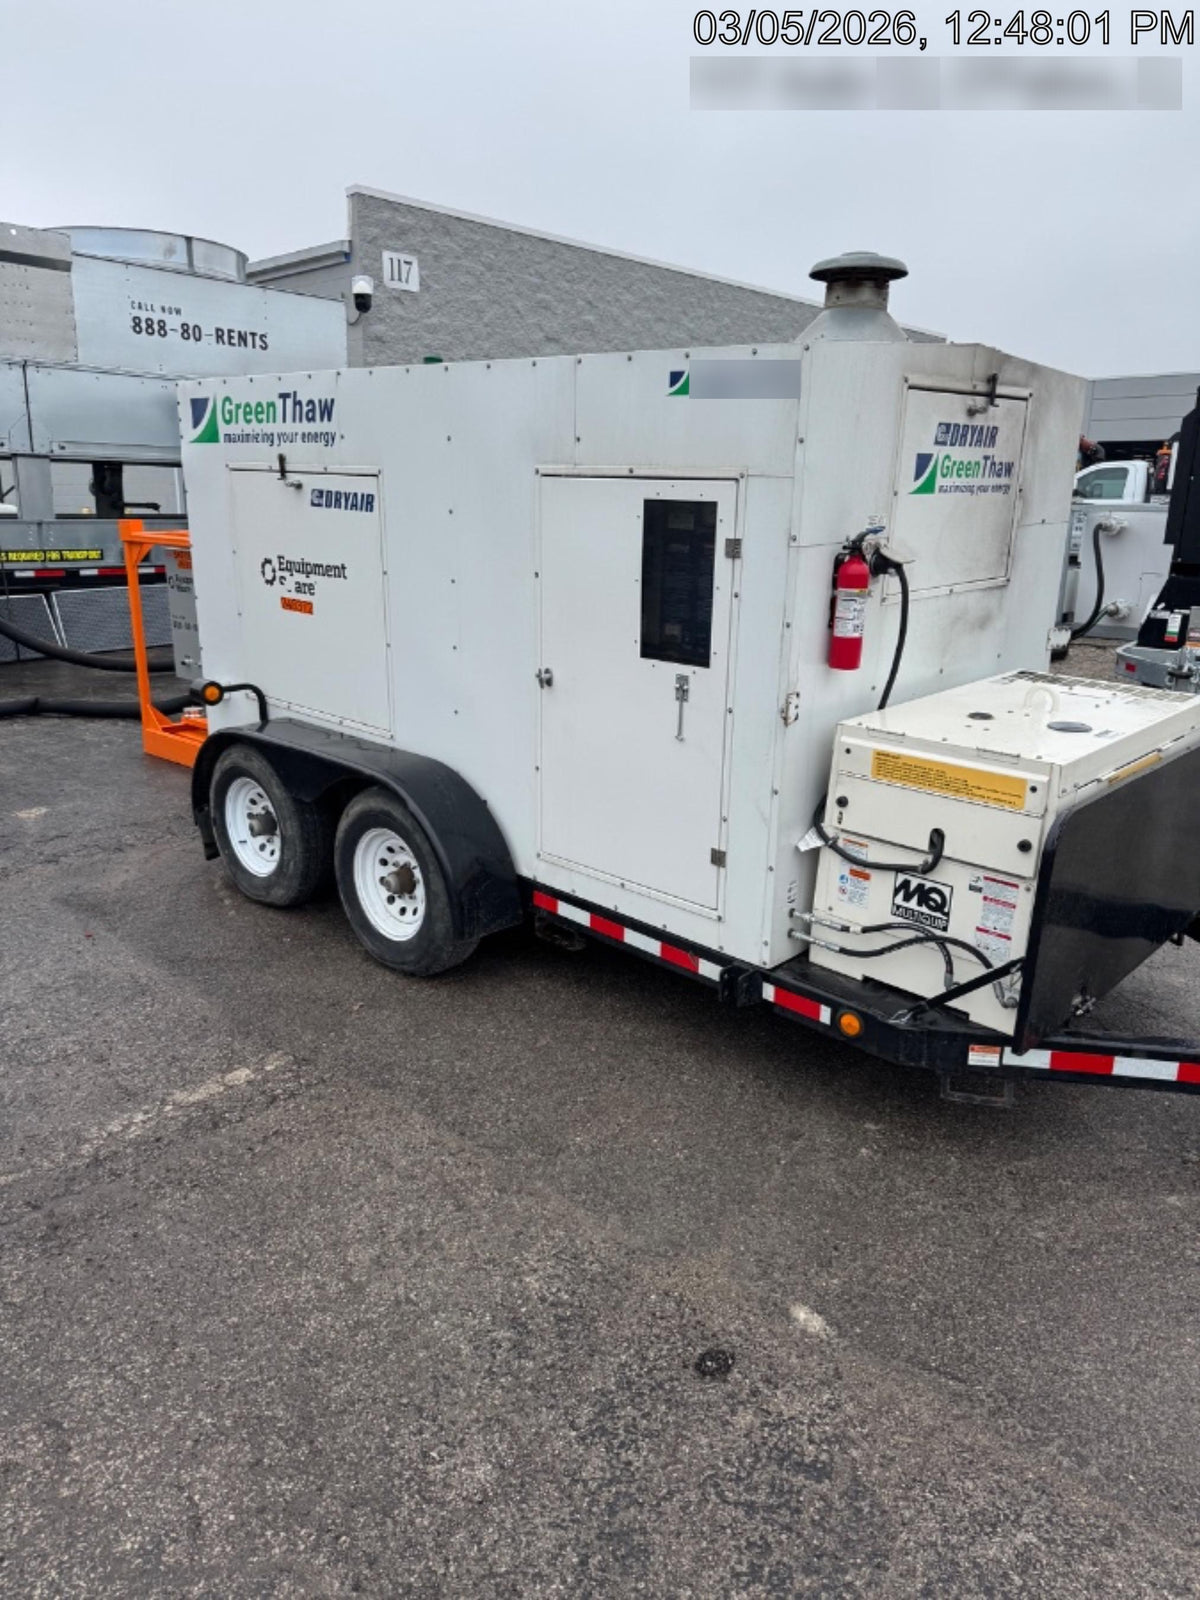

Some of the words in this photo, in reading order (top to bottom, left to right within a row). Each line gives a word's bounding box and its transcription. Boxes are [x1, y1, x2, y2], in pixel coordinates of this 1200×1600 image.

[388, 257, 413, 285] 117
[130, 300, 156, 313] CALL
[160, 304, 182, 316] NOW
[131, 315, 269, 351] 888-80-RENTS
[223, 429, 275, 447] maximizing
[276, 431, 299, 447] your
[300, 432, 336, 447] energy
[324, 489, 375, 513] DRYAIR
[277, 555, 347, 579] Equipment
[895, 877, 951, 917] MQ
[892, 904, 949, 932] MULTIQUIP
